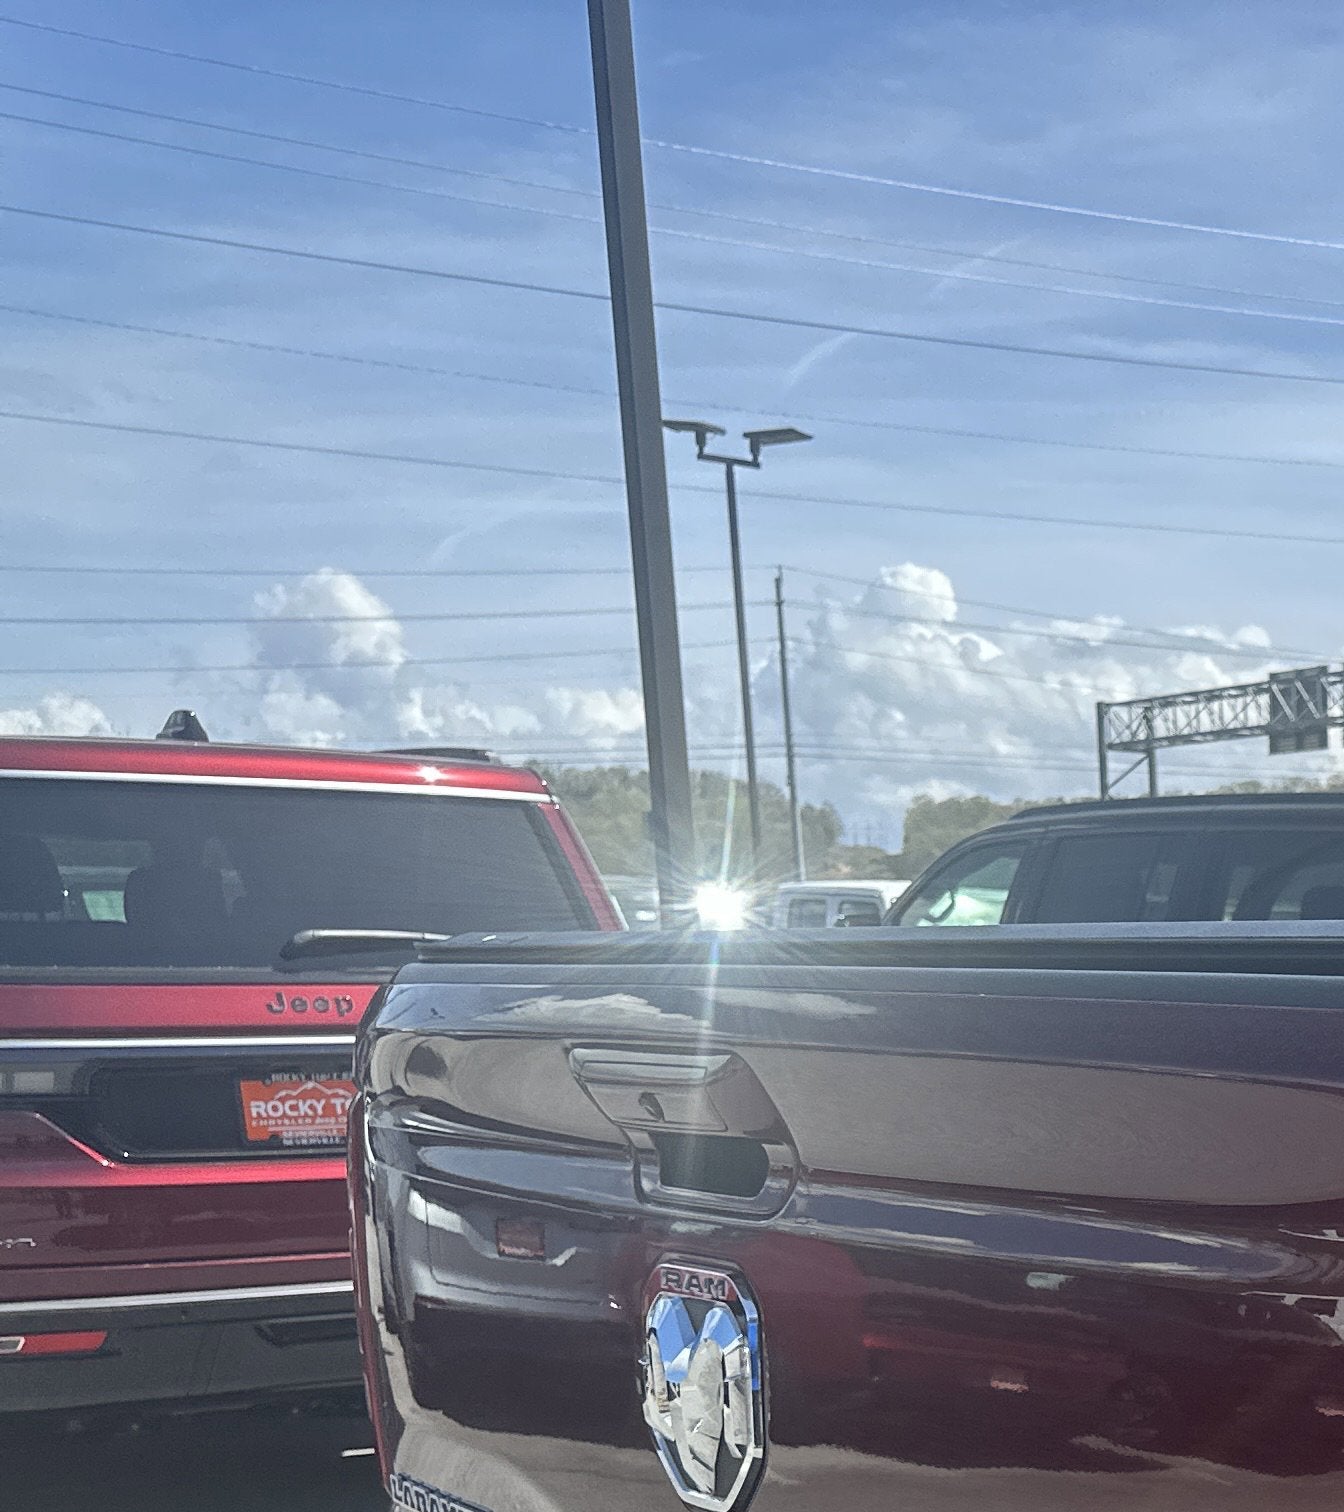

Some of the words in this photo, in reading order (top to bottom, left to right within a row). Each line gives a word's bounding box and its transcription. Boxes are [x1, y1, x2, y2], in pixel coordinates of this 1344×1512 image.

[266, 992, 354, 1017] Jeep
[250, 1098, 326, 1118] ROCKY
[660, 1268, 729, 1300] RAM
